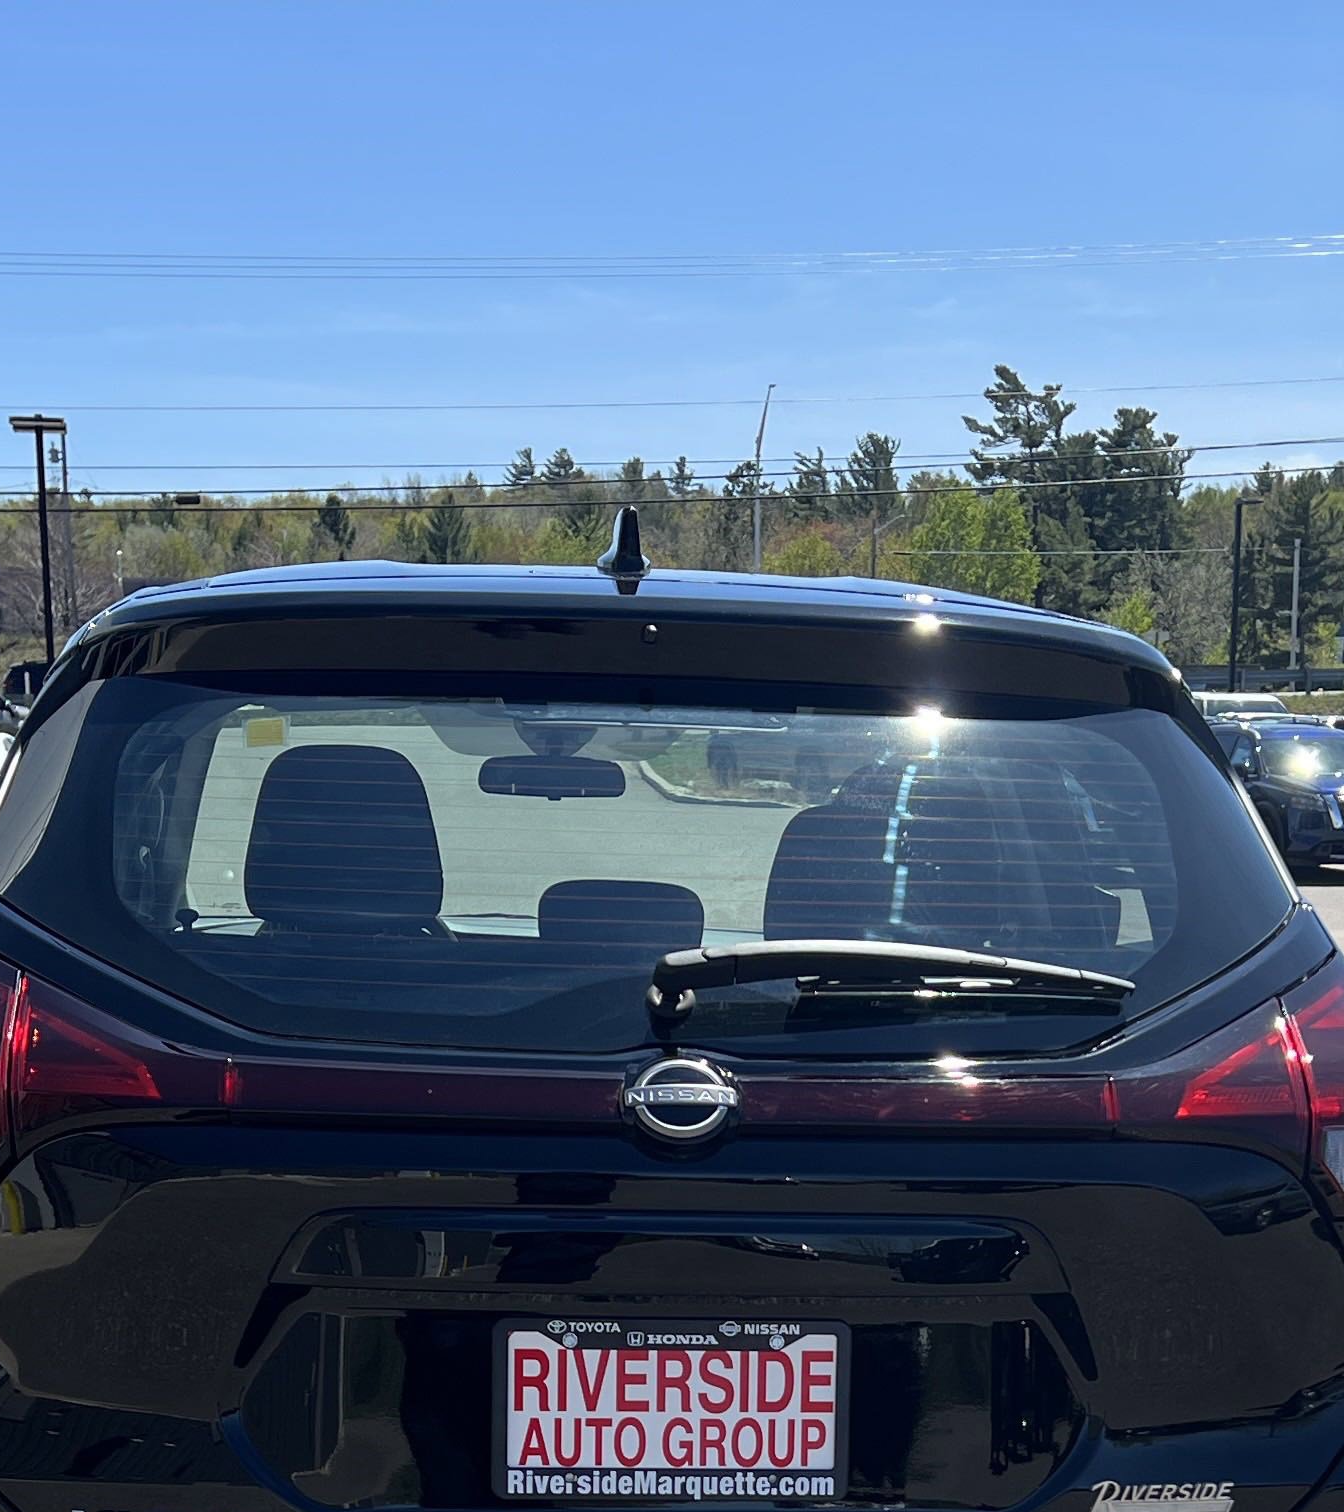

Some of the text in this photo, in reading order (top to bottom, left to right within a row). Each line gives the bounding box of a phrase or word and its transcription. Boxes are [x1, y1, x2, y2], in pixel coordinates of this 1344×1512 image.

[627, 1088, 735, 1105] NISSAN
[568, 1321, 622, 1333] TOYOTA
[743, 1323, 801, 1335] NISSAN
[646, 1334, 719, 1345] HONDA
[513, 1348, 834, 1414] RIVERSIDE
[518, 1416, 827, 1468] AUTO GROUP
[507, 1469, 835, 1500] RiversideMarquette.com
